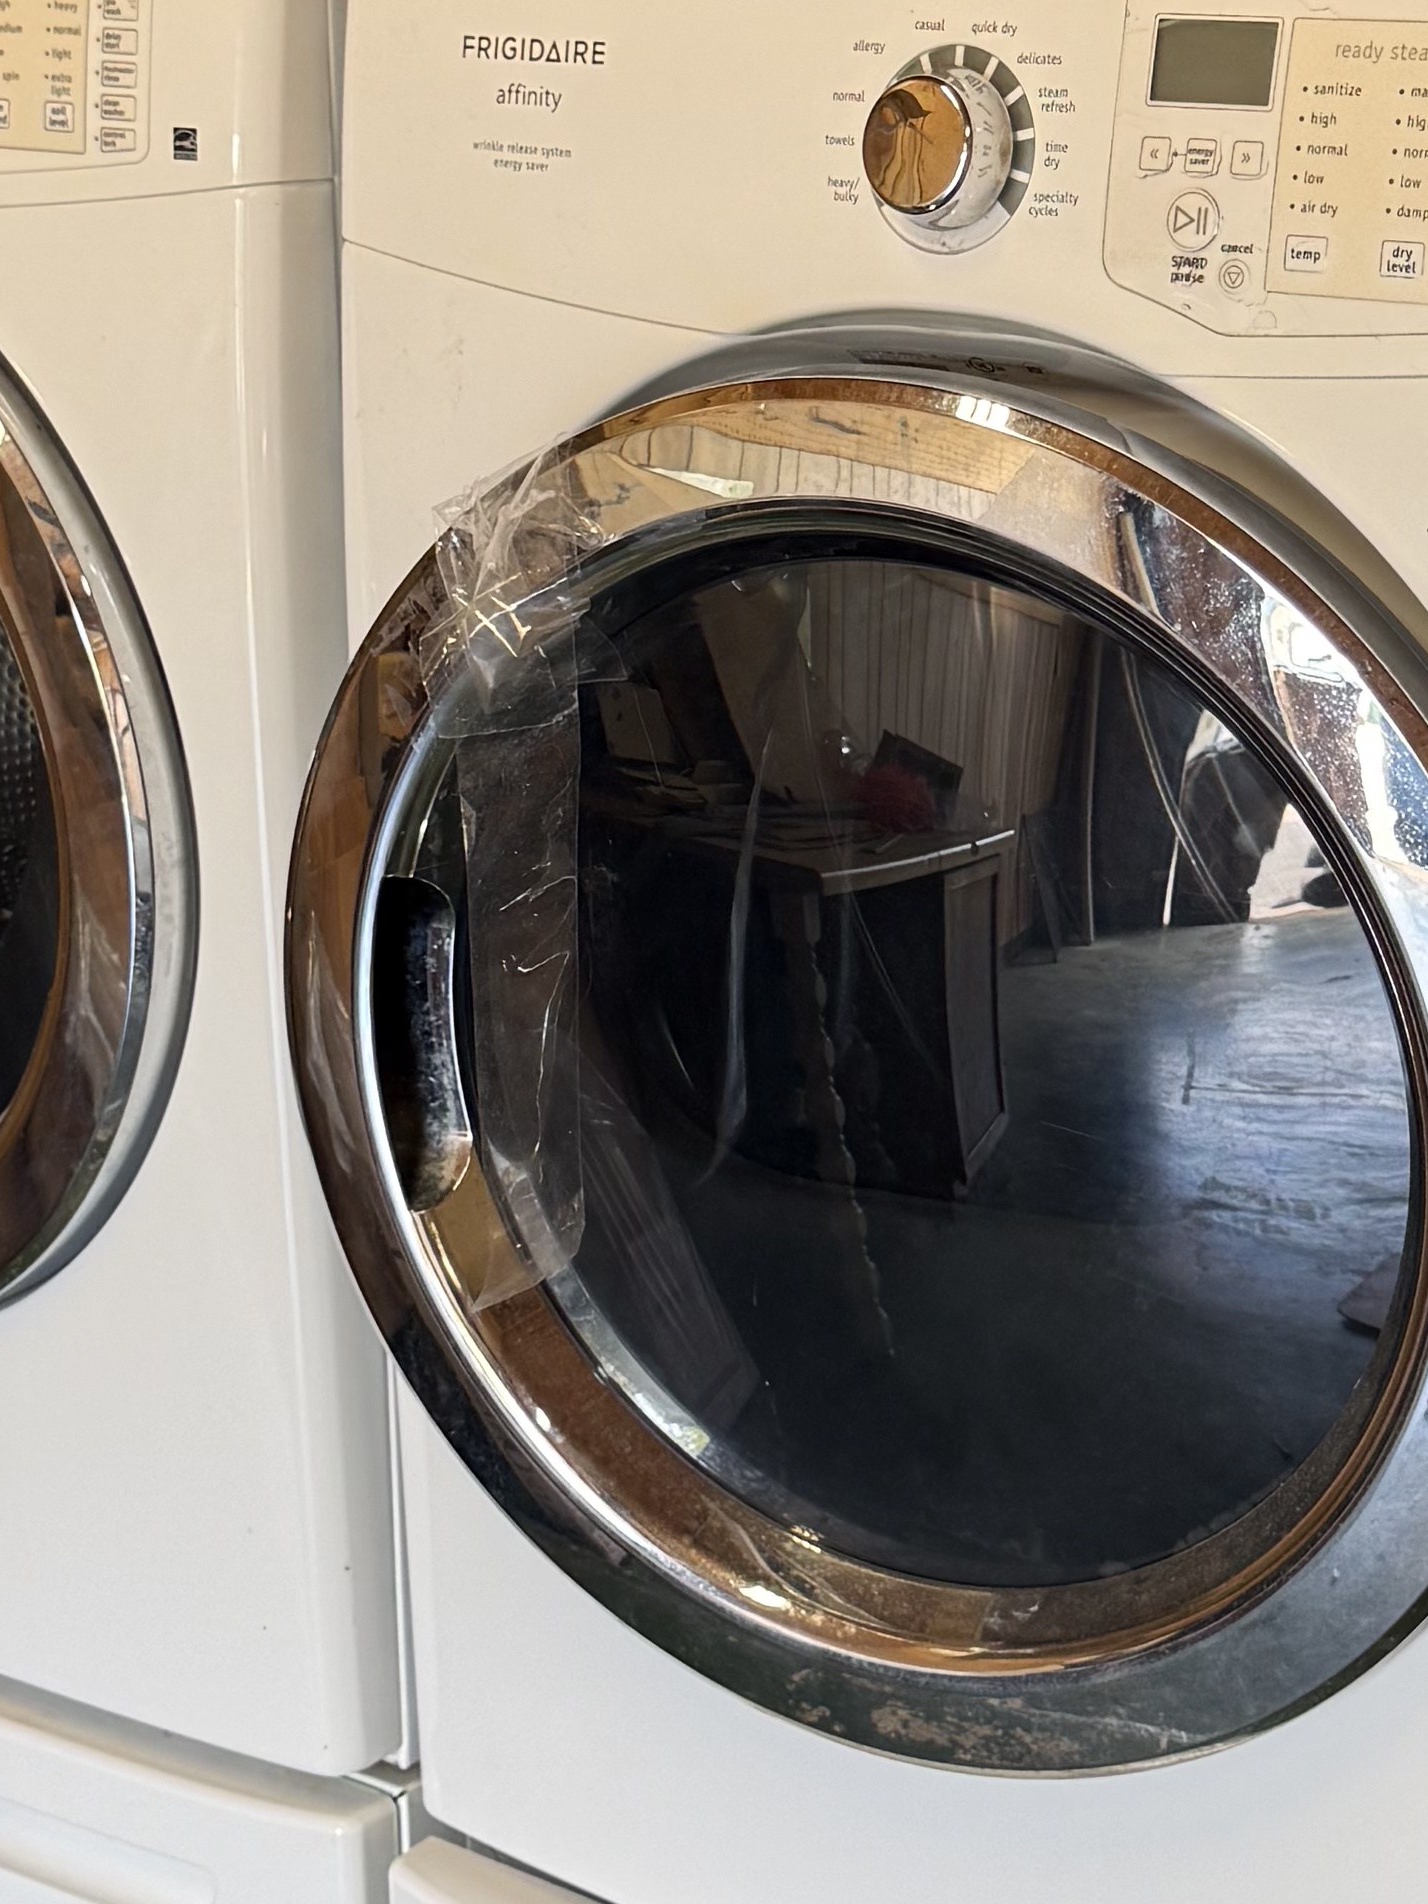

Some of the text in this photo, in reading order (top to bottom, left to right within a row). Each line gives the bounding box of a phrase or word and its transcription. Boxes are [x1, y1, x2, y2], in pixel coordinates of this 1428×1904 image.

[54, 0, 78, 14] heavy
[53, 25, 81, 36] normal
[915, 19, 945, 31] casual
[972, 20, 1018, 37] quick dry
[462, 35, 606, 65] FRIGIDAIRE
[853, 40, 886, 55] allergy
[1335, 40, 1384, 64] ready
[51, 48, 72, 62] light
[1017, 52, 1062, 66] delicates
[2, 71, 20, 82] spin
[51, 73, 72, 84] extra
[51, 85, 71, 99] light
[832, 90, 865, 102] normal
[1038, 87, 1068, 98] steam
[1313, 82, 1362, 97] sanitize
[496, 83, 562, 113] affinity
[51, 106, 67, 116] soil
[1041, 100, 1076, 113] refresh
[49, 117, 70, 128] level
[1310, 112, 1337, 128] high
[825, 134, 855, 146] towels
[1045, 140, 1068, 153] time
[473, 140, 572, 159] wrinkle release system
[1187, 147, 1214, 159] energy
[1307, 143, 1348, 157] normal
[493, 158, 549, 172] energy saver
[1044, 155, 1061, 170] dry
[1189, 157, 1210, 166] saver
[827, 176, 860, 191] heavy/
[1303, 170, 1325, 184] low
[1400, 174, 1422, 189] low
[834, 189, 859, 205] bulky
[1034, 190, 1079, 206] specialty
[1028, 201, 1059, 217] cycles
[1300, 200, 1338, 218] air dry
[1220, 243, 1254, 255] cancel
[1290, 248, 1321, 264] temp
[1392, 245, 1413, 262] dry
[1386, 259, 1416, 274] level
[1170, 269, 1205, 285] pause
